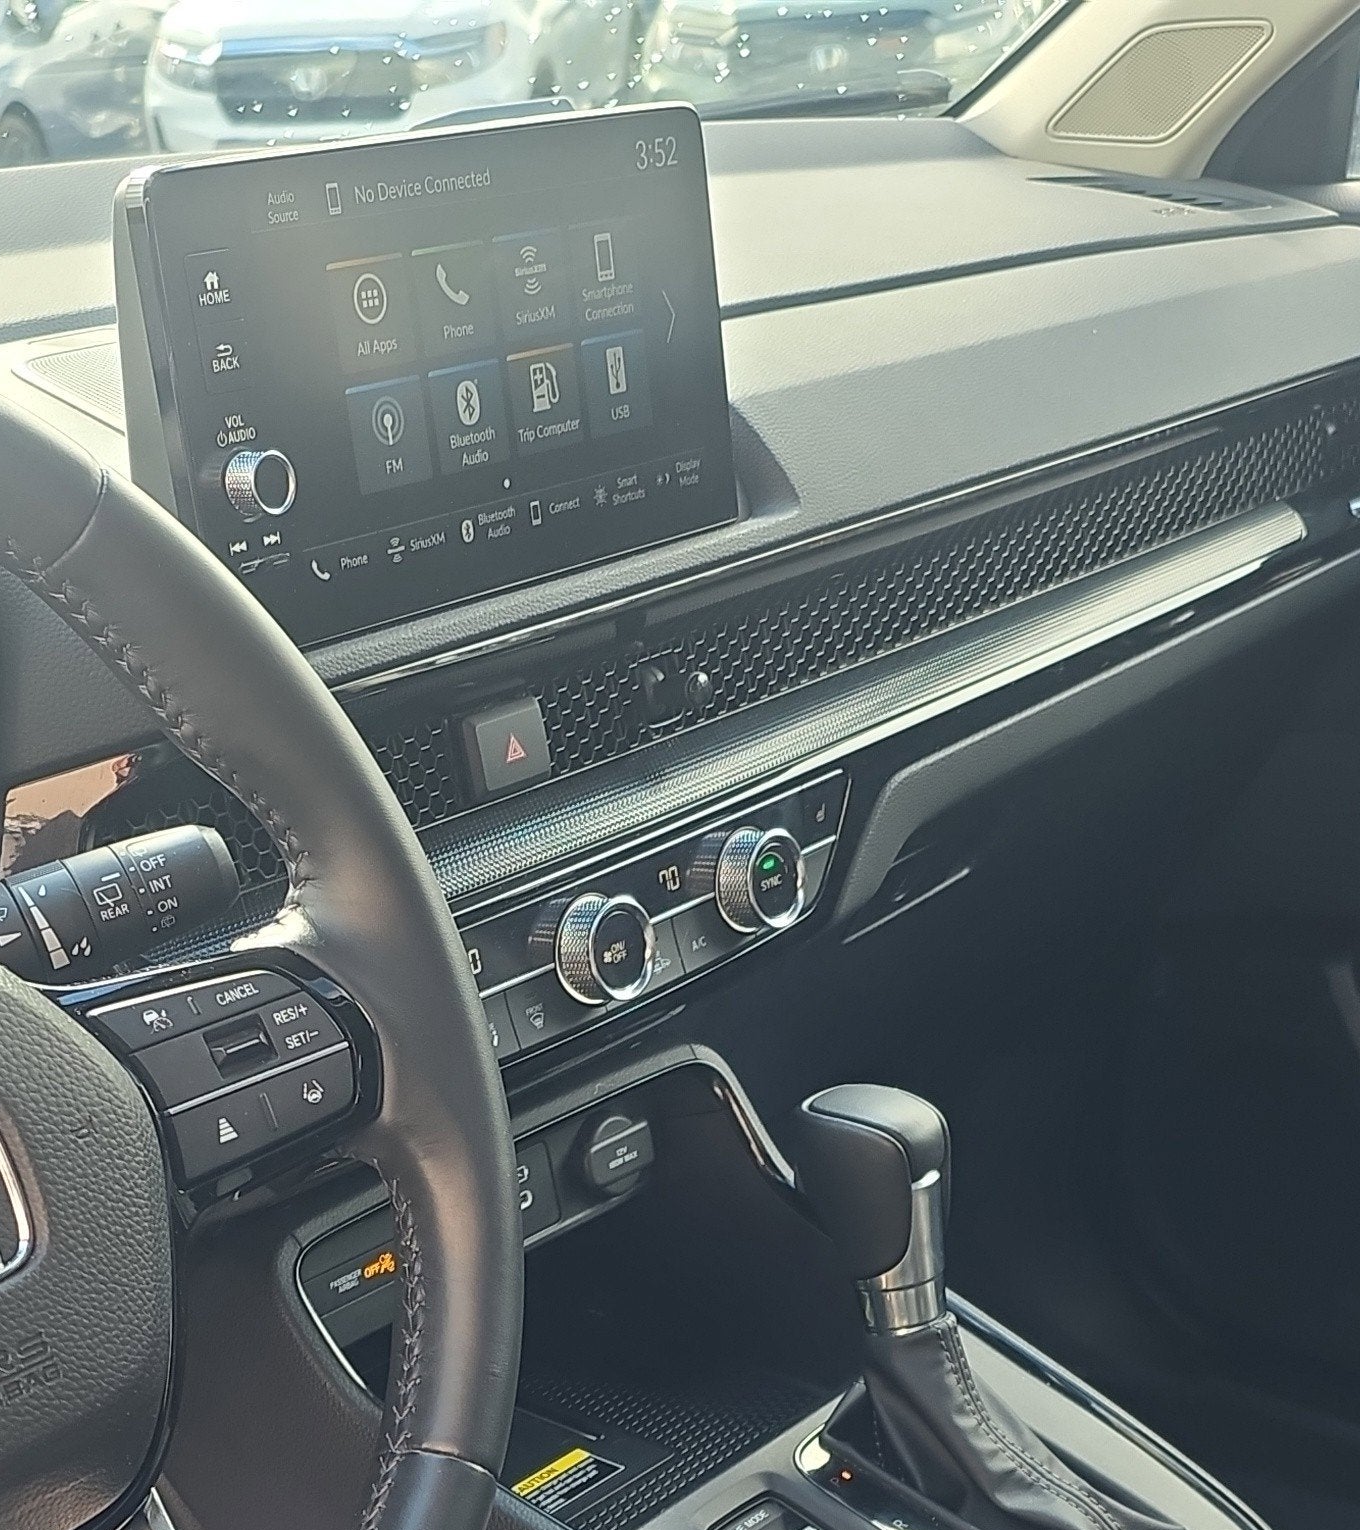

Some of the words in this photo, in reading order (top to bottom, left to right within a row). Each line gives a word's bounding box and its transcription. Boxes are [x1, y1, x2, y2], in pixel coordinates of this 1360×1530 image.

[635, 136, 678, 170] 3:52
[354, 186, 374, 204] No
[378, 179, 421, 201] Device
[425, 168, 491, 194] Connected
[267, 190, 295, 205] Audio
[268, 210, 299, 224] Source
[198, 289, 231, 306] HOME
[582, 283, 634, 302] Smartphone
[516, 305, 556, 326] SiriusXM
[585, 302, 634, 322] Connection
[443, 324, 474, 340] Phone
[357, 341, 372, 357] All
[373, 337, 398, 354] Apps
[212, 356, 240, 373] BACK
[225, 414, 245, 429] VOL
[611, 404, 630, 421] USB
[228, 427, 257, 445] AUDIO
[449, 427, 496, 450] Bluetooth
[517, 427, 535, 443] Trip
[536, 418, 580, 439] Computer
[385, 458, 404, 475] FM
[462, 449, 489, 467] Audio
[616, 473, 638, 489] Smart
[548, 497, 581, 514] Connect
[478, 507, 516, 526] Bluetooth
[409, 531, 446, 552] SiriusXM
[487, 525, 511, 540] Audio
[340, 554, 369, 570] Phone
[140, 854, 166, 872] OFF
[149, 875, 172, 893] INT
[658, 865, 681, 891] 70
[760, 874, 782, 892] SYNC
[99, 903, 130, 922] REAR
[157, 897, 178, 913] ON
[691, 935, 707, 951] A/C
[613, 949, 628, 964] OFF
[216, 982, 259, 1006] CANCEL
[744, 1509, 769, 1528] MODE
[892, 1519, 909, 1530] R
